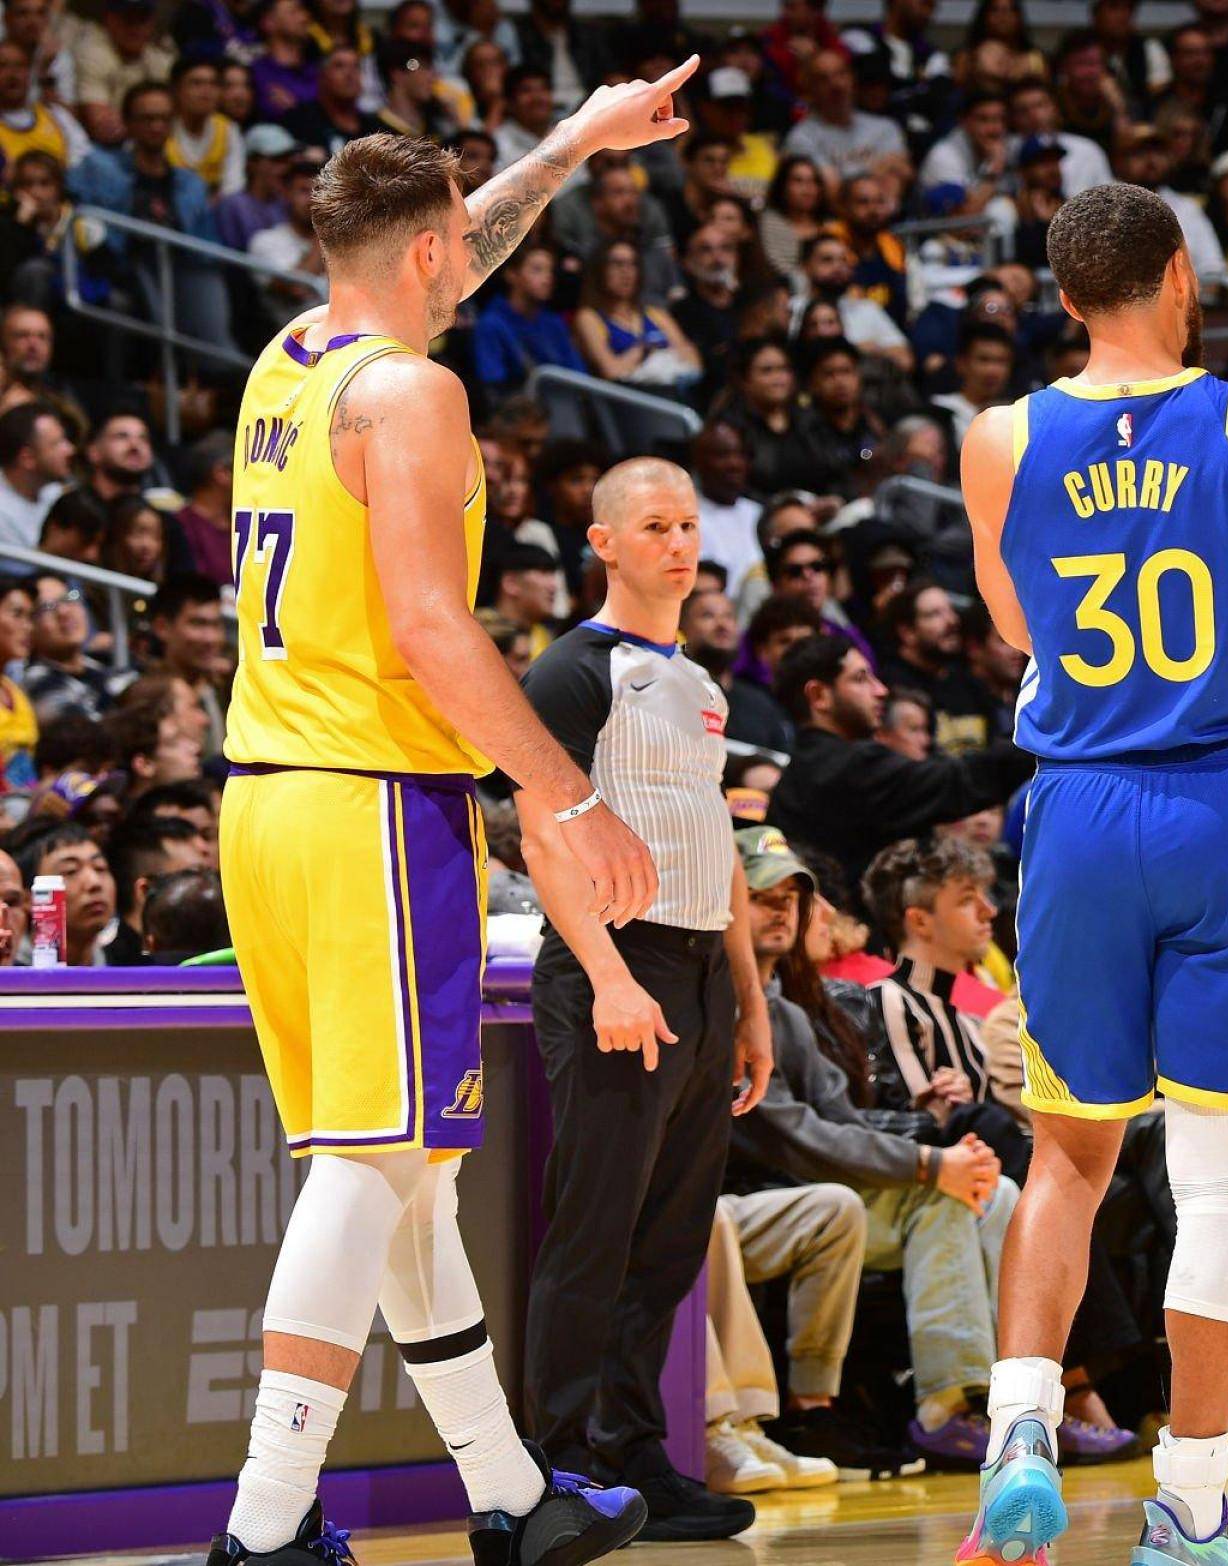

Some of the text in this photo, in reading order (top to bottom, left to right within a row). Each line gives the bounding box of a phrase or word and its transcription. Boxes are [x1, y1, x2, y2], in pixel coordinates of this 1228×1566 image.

[1063, 459, 1189, 518] CURRY
[233, 507, 295, 661] 77
[1050, 548, 1216, 688] 30
[0, 1305, 58, 1459] M
[77, 1300, 137, 1455] ET
